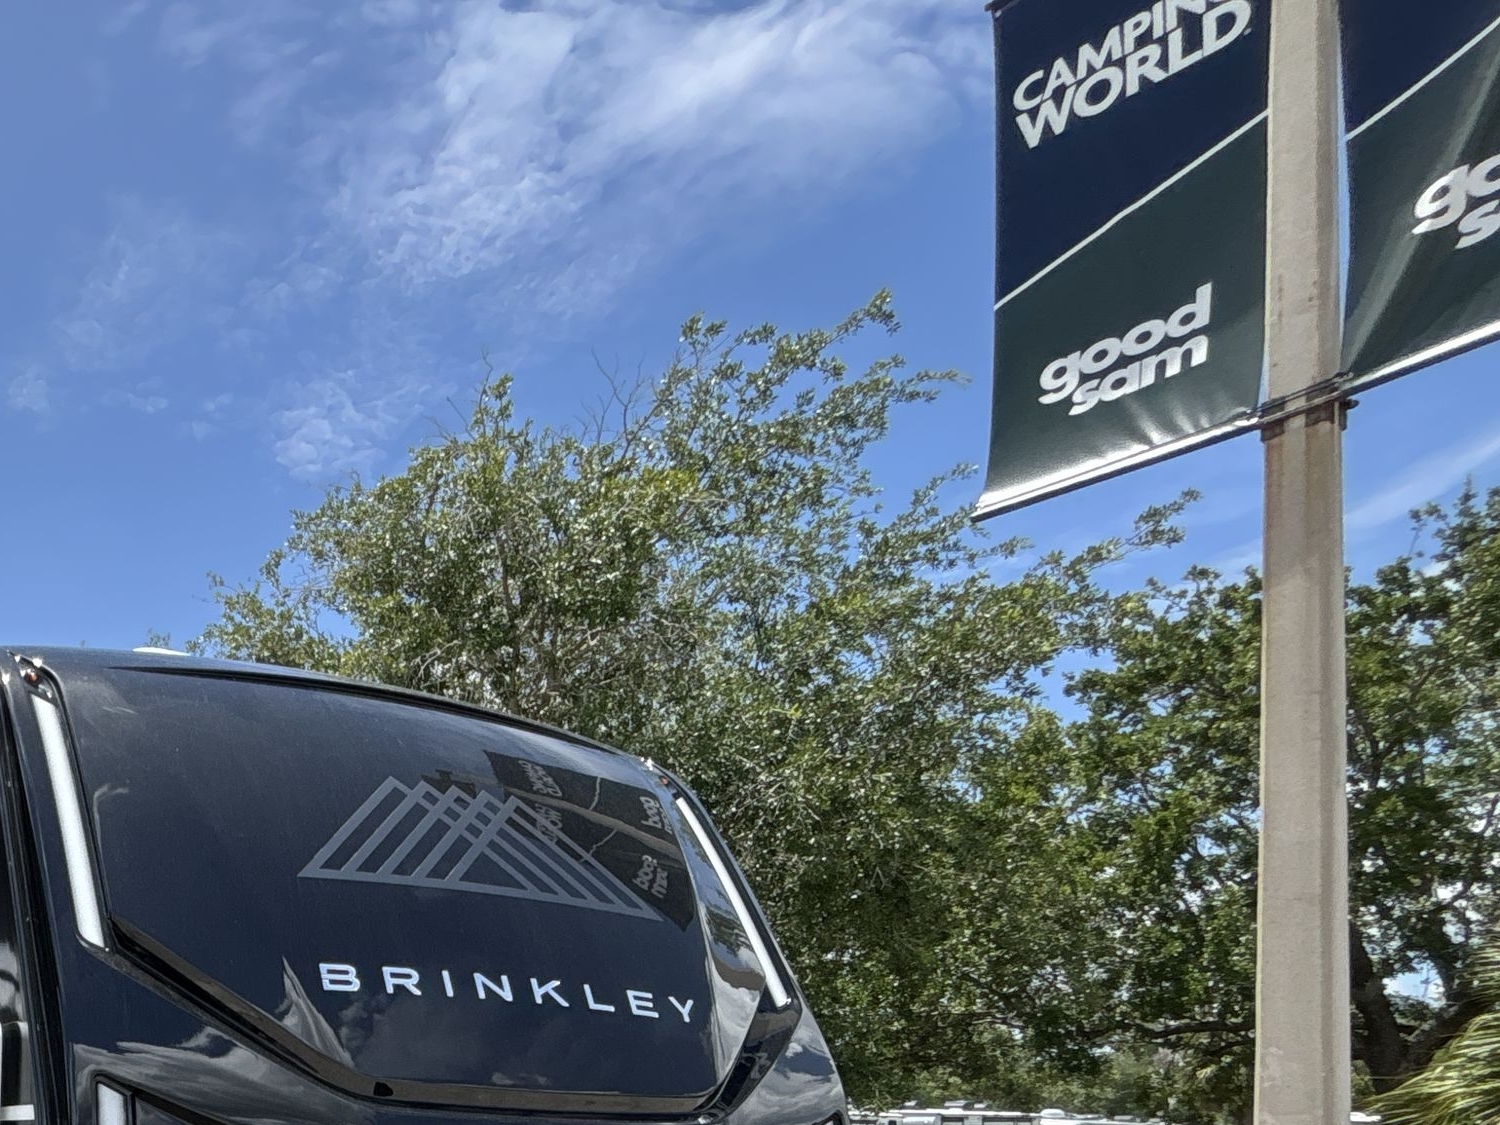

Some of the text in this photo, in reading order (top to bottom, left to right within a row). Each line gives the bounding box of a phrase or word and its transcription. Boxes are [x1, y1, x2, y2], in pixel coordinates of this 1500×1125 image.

[1013, 0, 1211, 111] CAMPIN
[1015, 0, 1251, 149] WORLD
[1038, 281, 1212, 404] good
[1068, 335, 1209, 415] sam
[318, 962, 694, 1023] BRINKLEY
